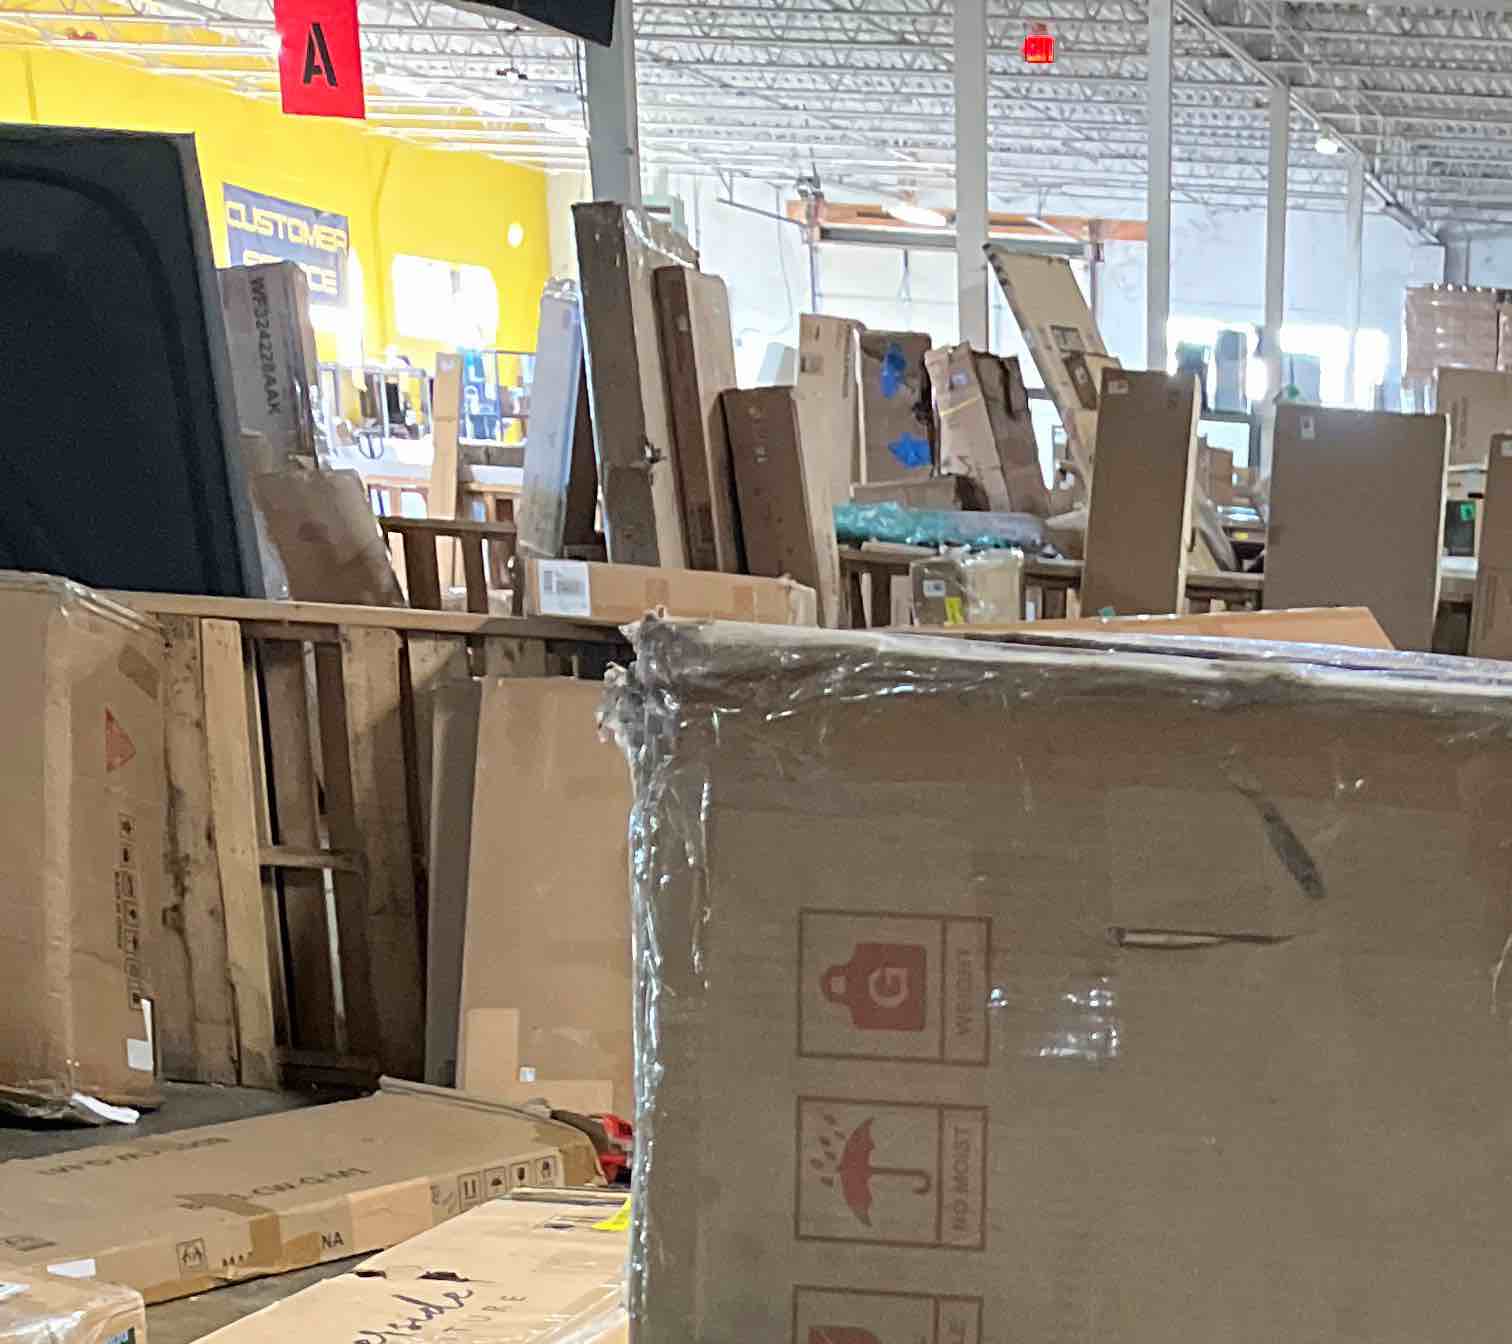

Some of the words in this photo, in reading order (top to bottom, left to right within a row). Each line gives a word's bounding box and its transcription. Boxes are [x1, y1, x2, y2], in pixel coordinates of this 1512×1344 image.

[302, 22, 338, 87] A
[225, 202, 348, 256] CUSTOMER
[954, 1126, 972, 1184] MOIST
[954, 1188, 971, 1232] NO
